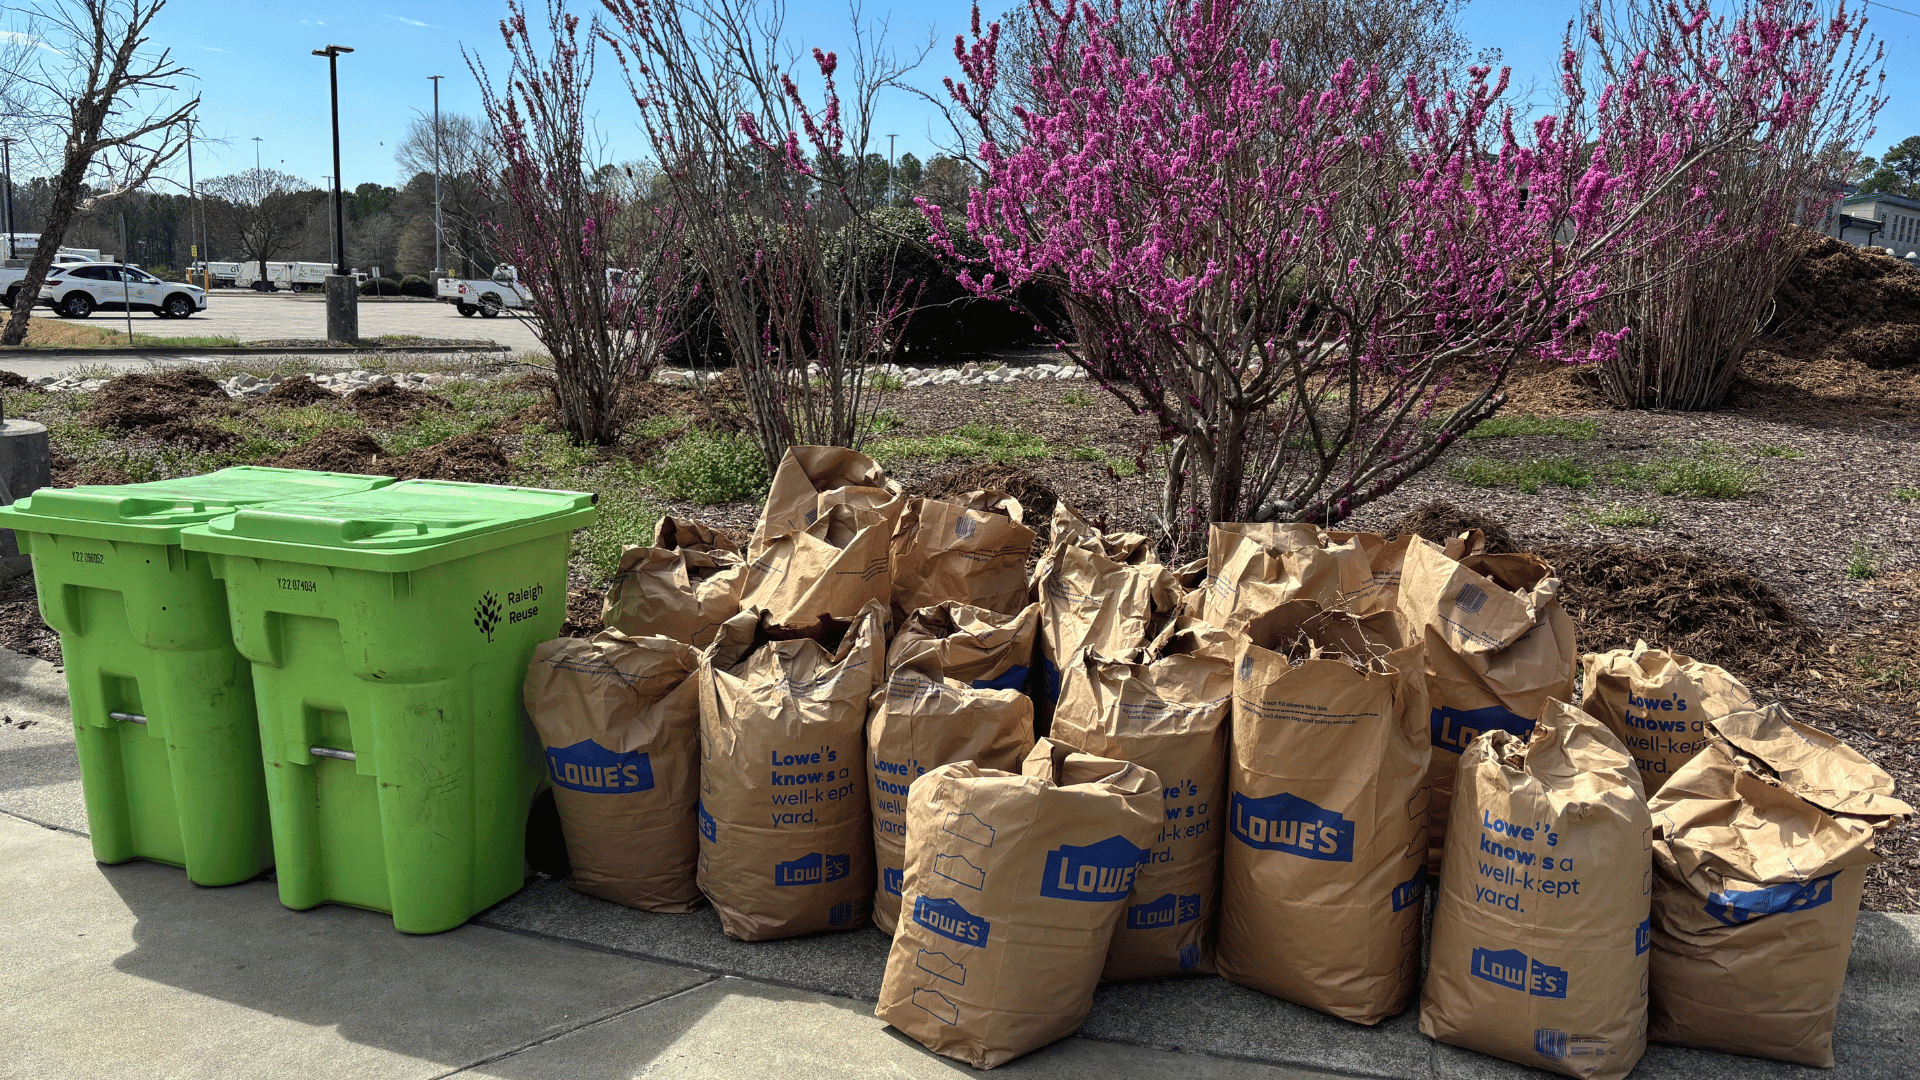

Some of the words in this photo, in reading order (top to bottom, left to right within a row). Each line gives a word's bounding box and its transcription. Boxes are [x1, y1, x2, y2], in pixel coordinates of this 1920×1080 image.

[508, 582, 543, 605] Raleigh
[509, 606, 539, 625] Reuse
[1628, 689, 1687, 712] Lowe's
[1291, 715, 1302, 723] top
[1625, 709, 1686, 733] knows
[1690, 721, 1704, 733] a
[1625, 734, 1708, 755] well-kept
[550, 756, 640, 788] LOWE'S
[771, 771, 835, 786] knows
[839, 767, 849, 779] a
[1635, 758, 1673, 774] ard.
[771, 782, 855, 806] well-kept
[875, 773, 910, 797] know
[771, 808, 818, 828] yard.
[877, 797, 906, 816] well-
[1198, 803, 1207, 815] a
[878, 817, 906, 836] yard
[1236, 803, 1338, 854] LOWE'S
[1151, 846, 1174, 864] rd.
[1480, 832, 1555, 870] knows
[1560, 858, 1573, 872] a
[783, 861, 845, 883] LOWE'S
[1478, 860, 1580, 899] well-kept
[1475, 884, 1525, 913] yard.
[920, 902, 980, 941] LOWE'S
[1136, 902, 1195, 925] LOWE'S
[1480, 954, 1558, 993] LOWE'S
